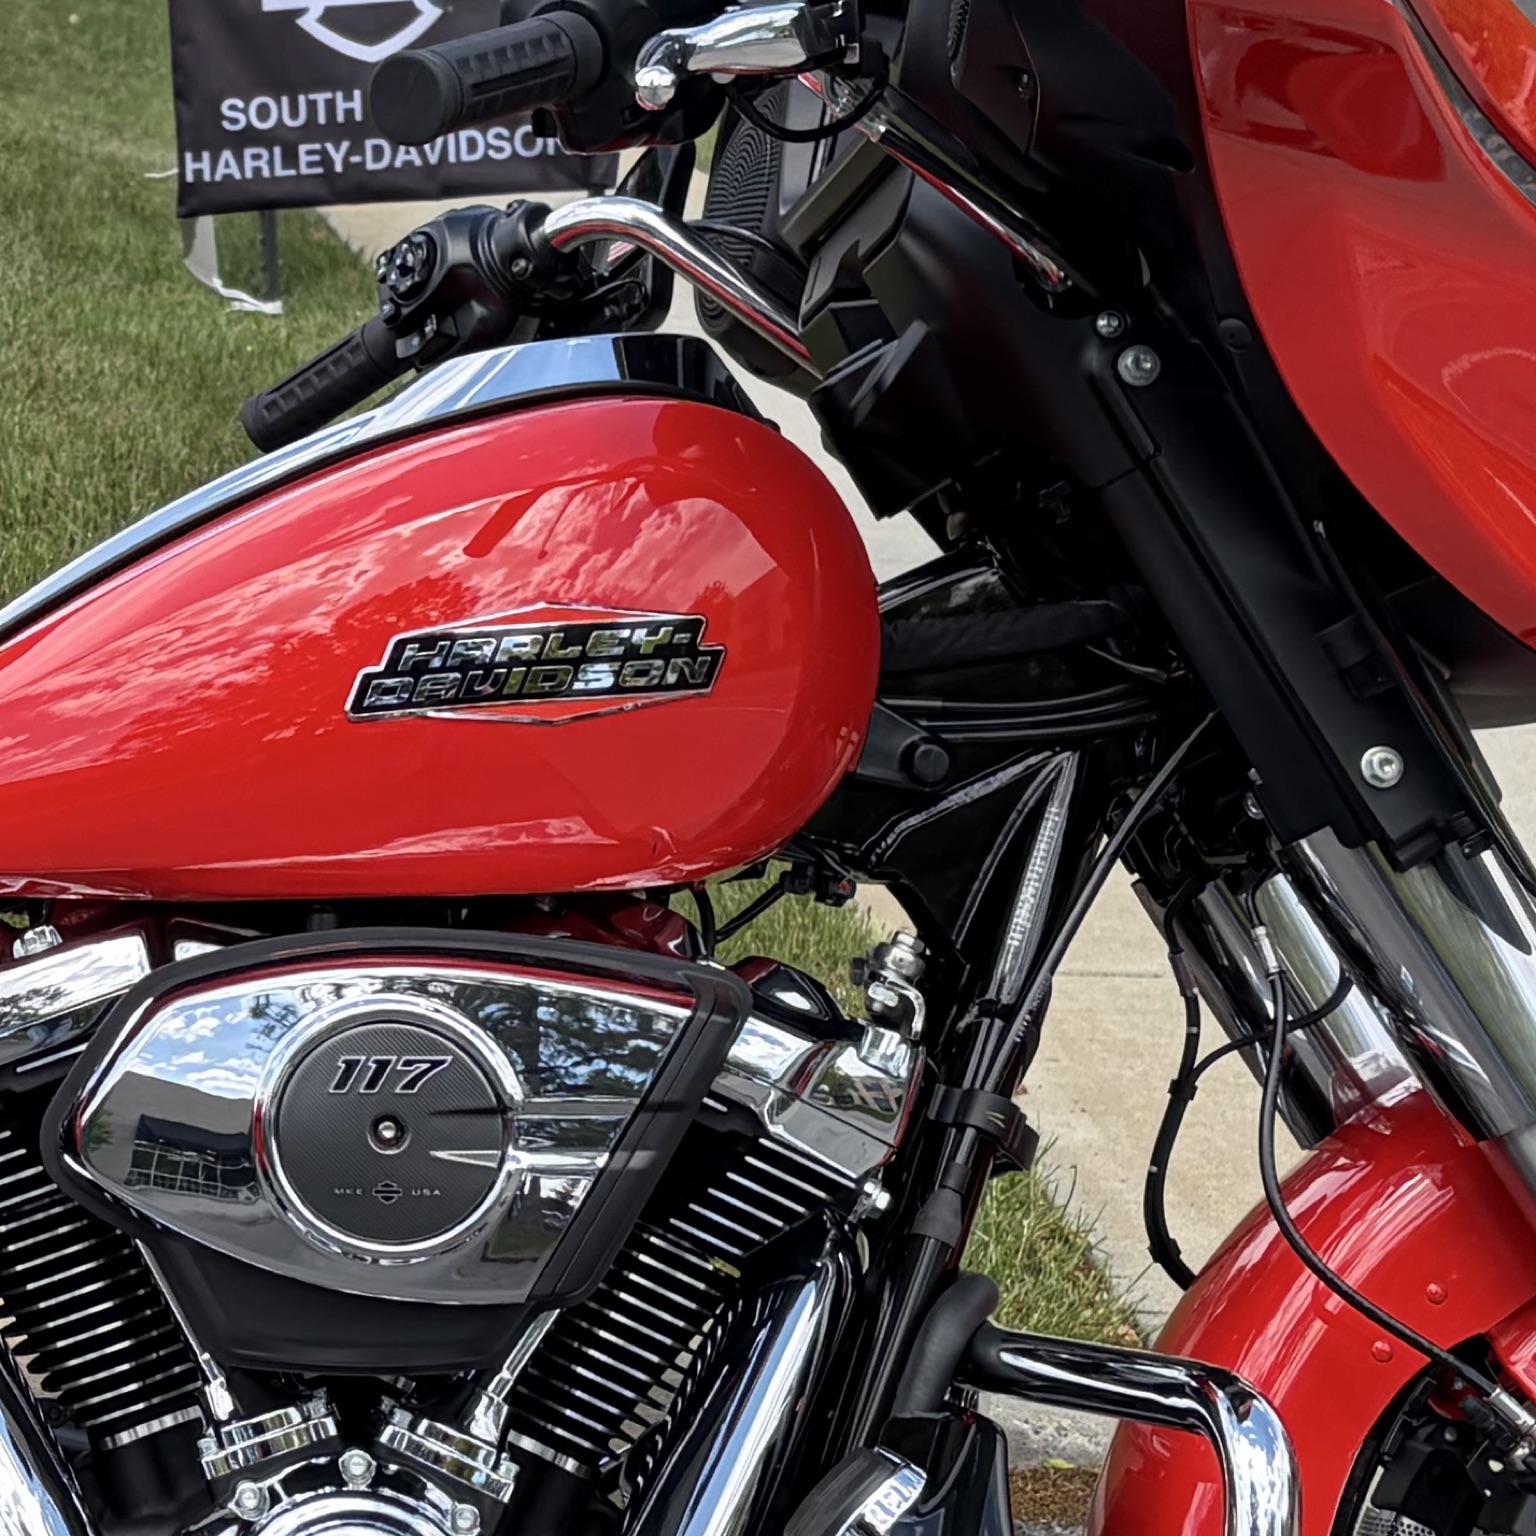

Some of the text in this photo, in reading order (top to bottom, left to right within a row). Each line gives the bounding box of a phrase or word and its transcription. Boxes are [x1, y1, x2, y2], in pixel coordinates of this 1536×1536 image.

[220, 89, 363, 132] SOUTH
[397, 626, 693, 671] HARLEY-
[362, 655, 712, 708] DAVIDSON
[328, 1055, 453, 1095] 117
[411, 1188, 442, 1196] USA
